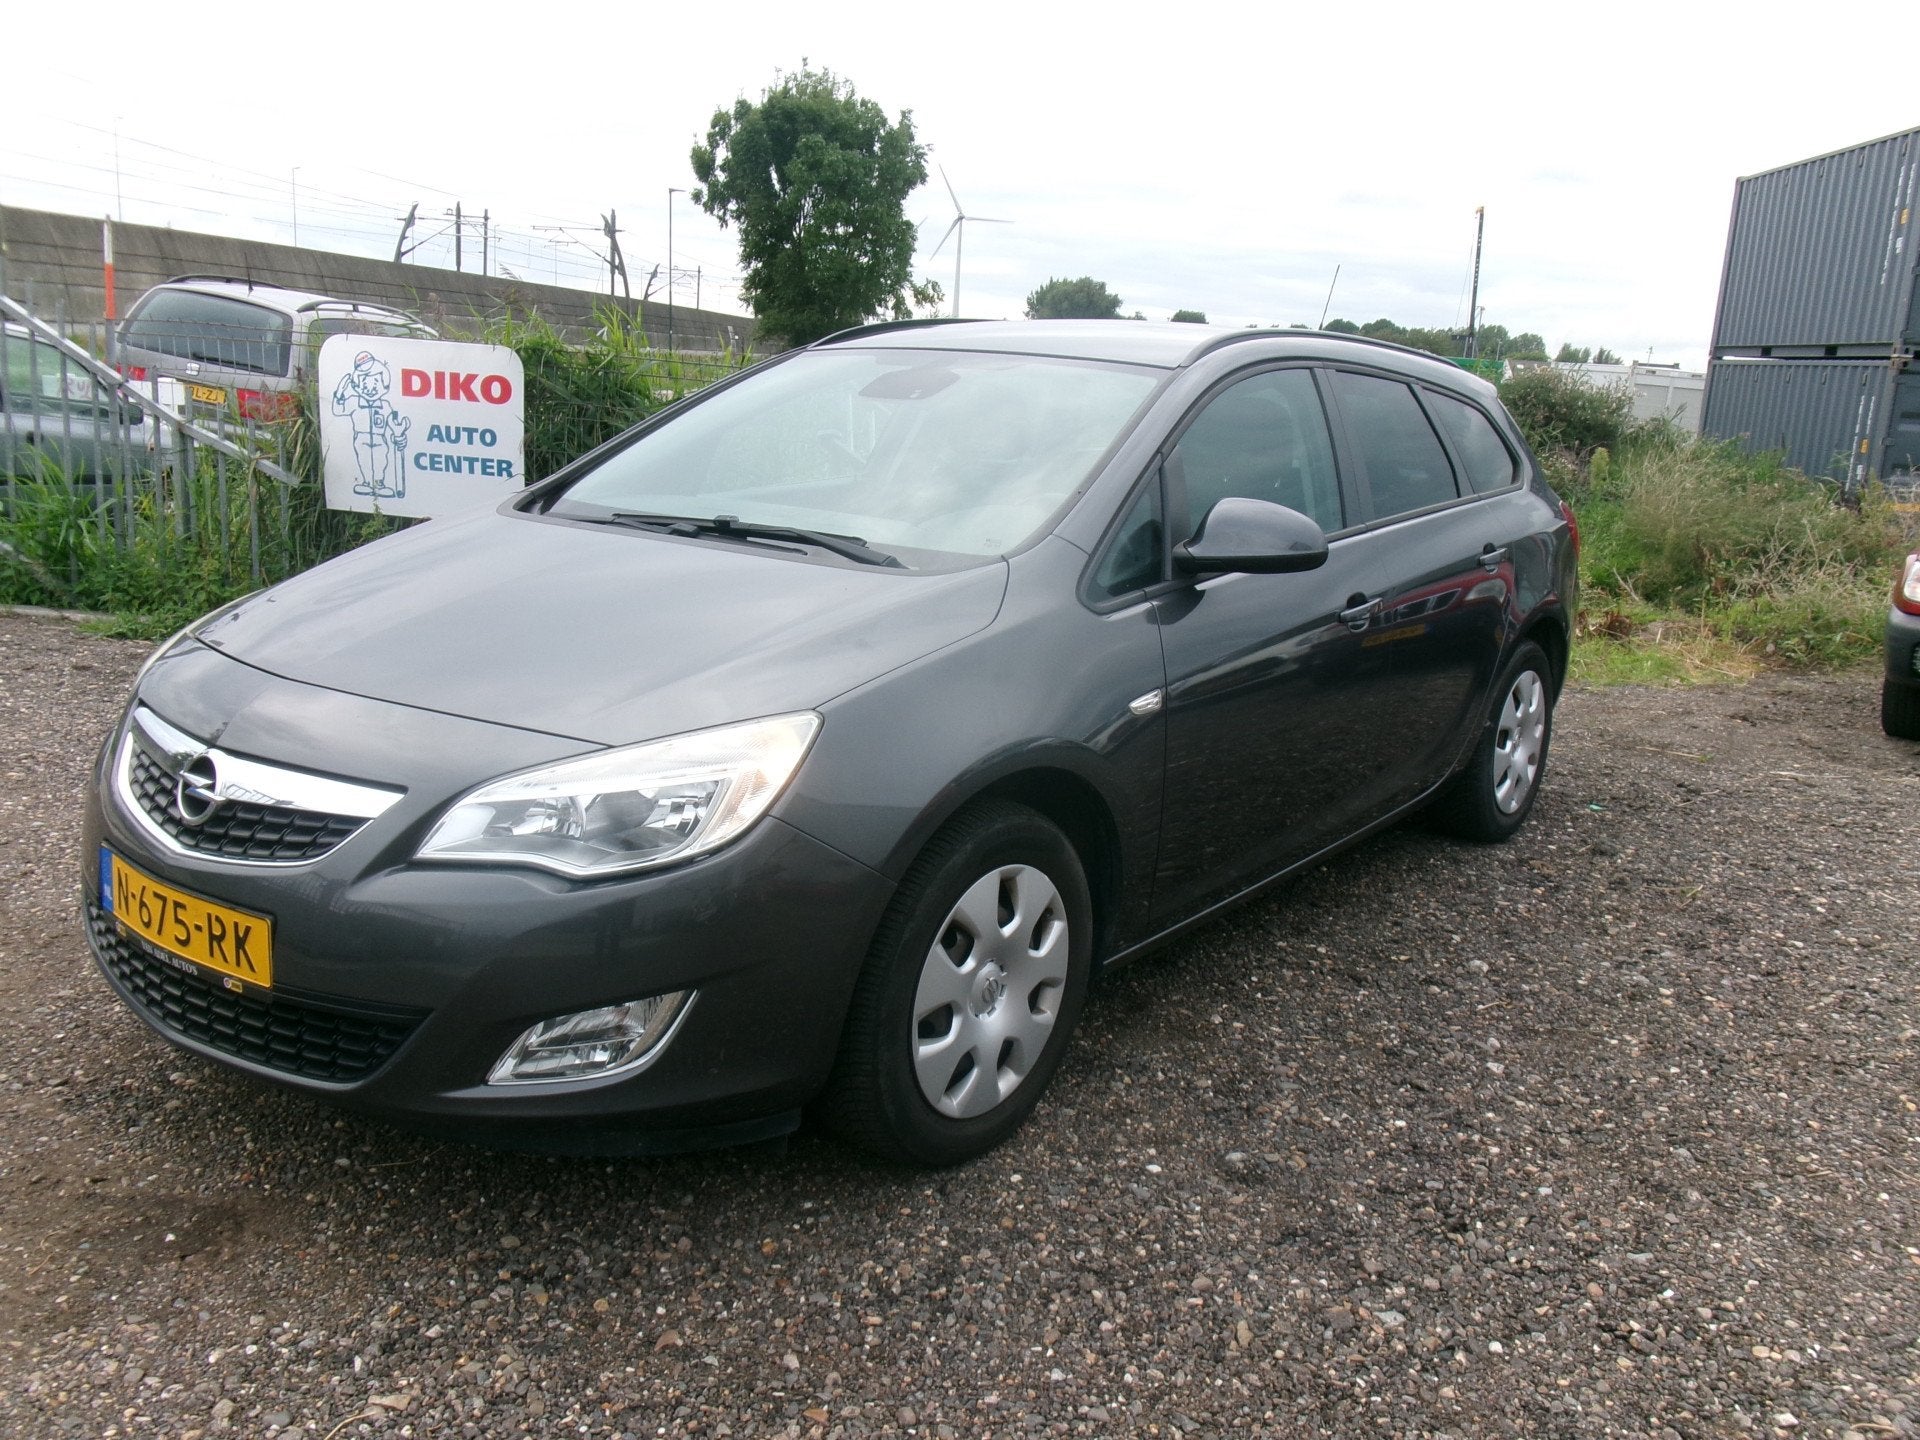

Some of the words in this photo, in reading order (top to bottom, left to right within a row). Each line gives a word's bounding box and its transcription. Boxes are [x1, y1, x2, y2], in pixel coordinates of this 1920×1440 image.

[401, 368, 512, 405] DIKO
[427, 424, 497, 447] AUTO
[413, 452, 513, 478] CENTER
[117, 867, 256, 973] N-675-RK
